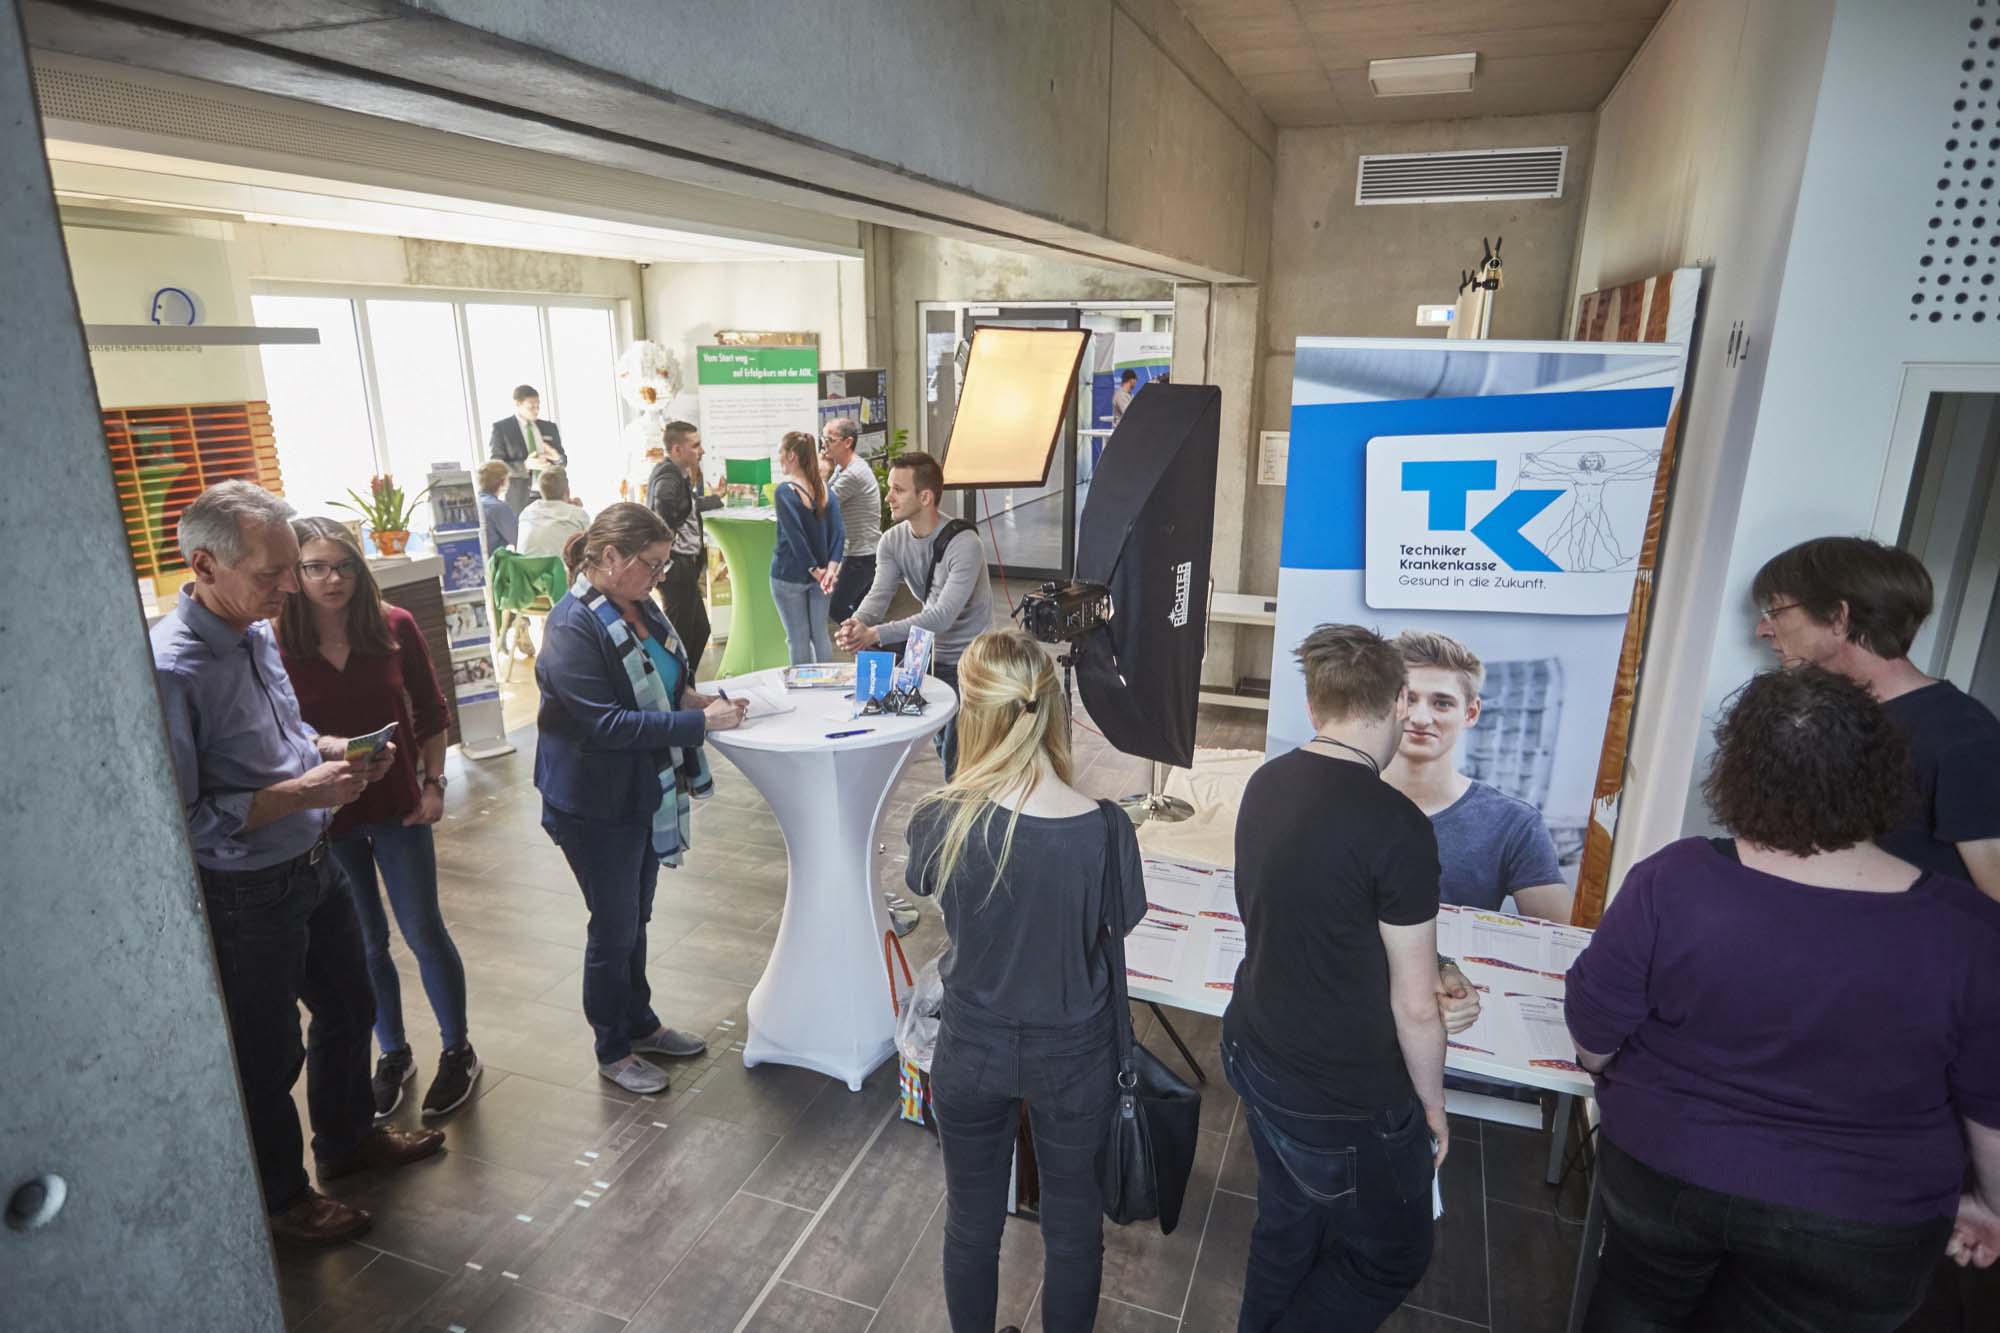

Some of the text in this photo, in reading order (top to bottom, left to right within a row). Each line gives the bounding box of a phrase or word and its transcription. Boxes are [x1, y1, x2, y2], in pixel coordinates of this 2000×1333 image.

[719, 353, 734, 362] Start
[735, 355, 748, 365] weg
[778, 368, 786, 377] mit
[787, 368, 798, 377] der
[1400, 544, 1467, 556] Techniker
[1400, 559, 1497, 571] Krankenkasse
[1399, 575, 1547, 590] Gesund in die Zukunft.
